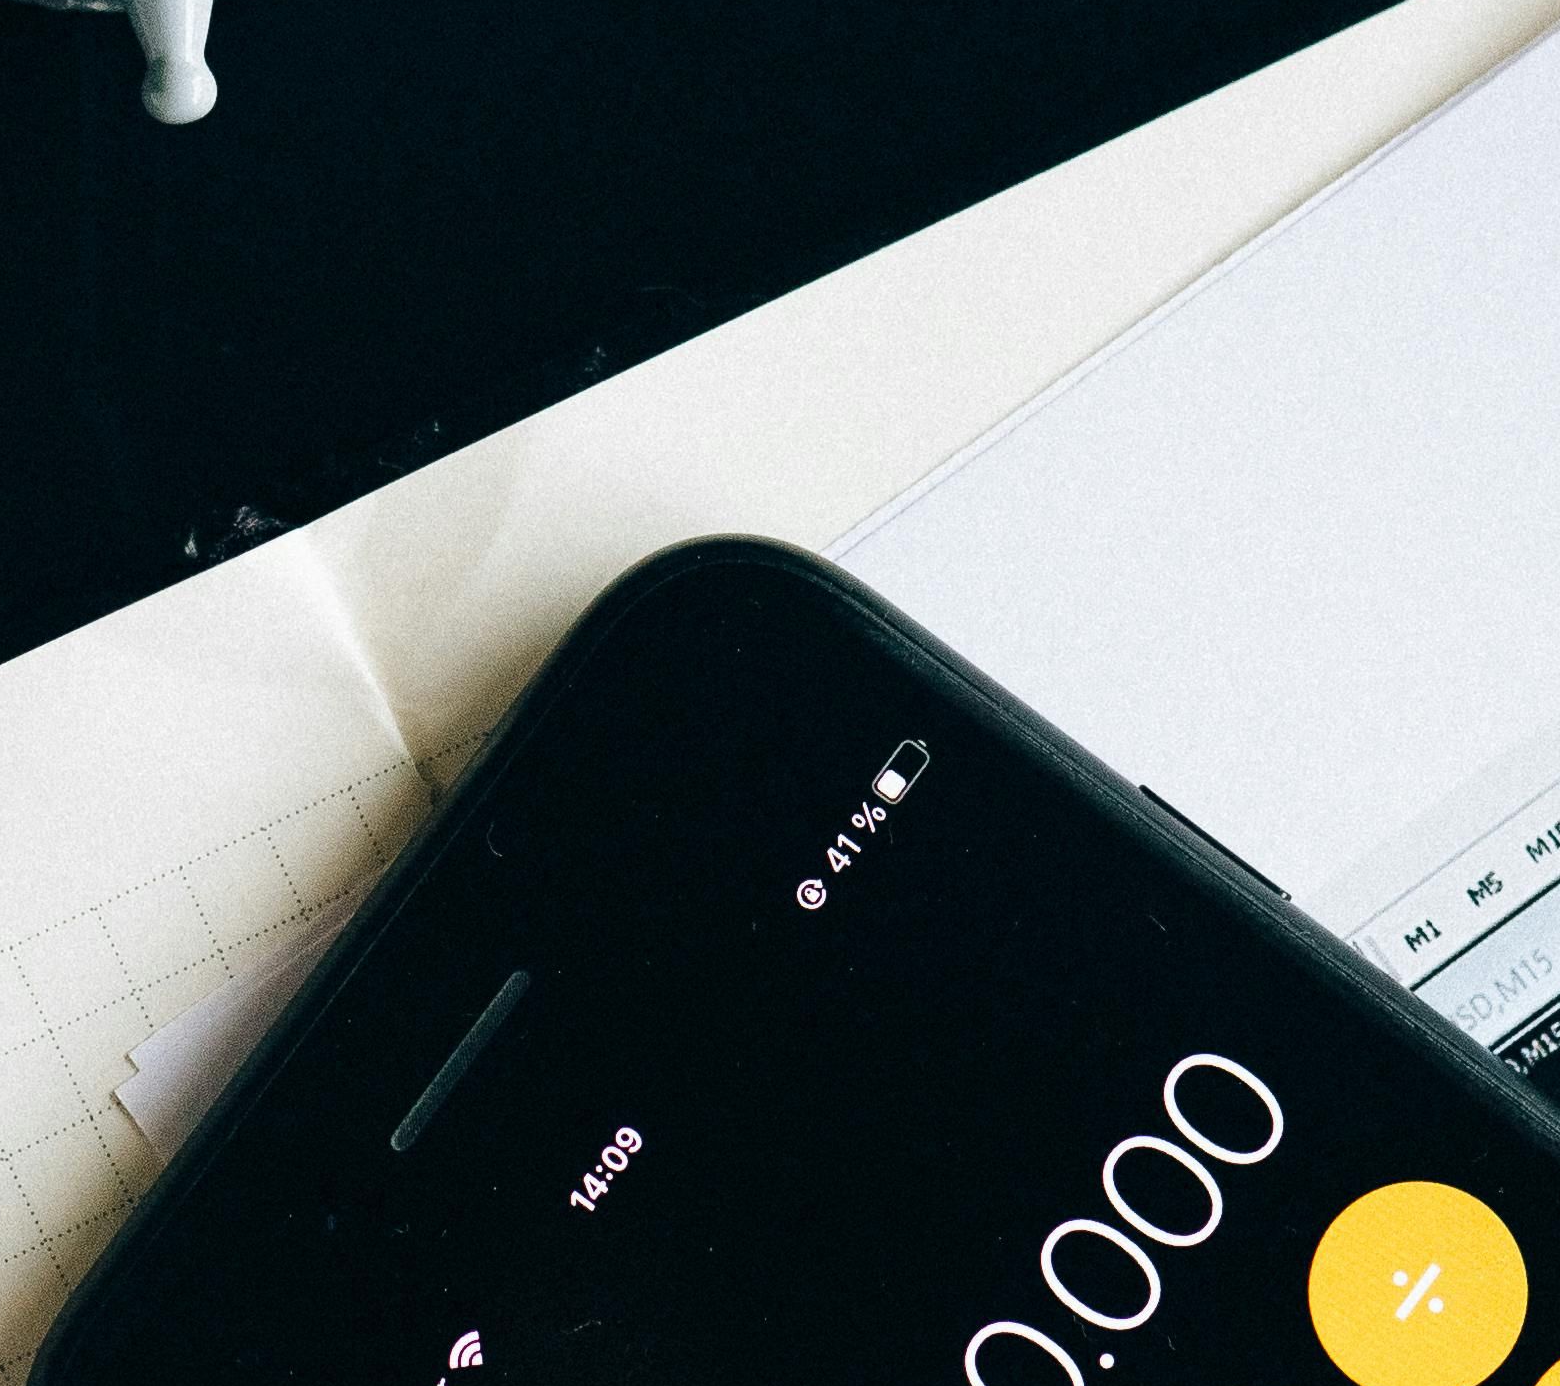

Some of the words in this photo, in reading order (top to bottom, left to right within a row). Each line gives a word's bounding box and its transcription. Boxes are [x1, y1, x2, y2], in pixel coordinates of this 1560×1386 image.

[825, 831, 861, 876] 41
[851, 800, 889, 836] %
[1404, 918, 1442, 954] M1
[1466, 871, 1505, 908] M5
[1450, 948, 1554, 1033] SD,M15
[569, 1125, 645, 1213] 14:09
